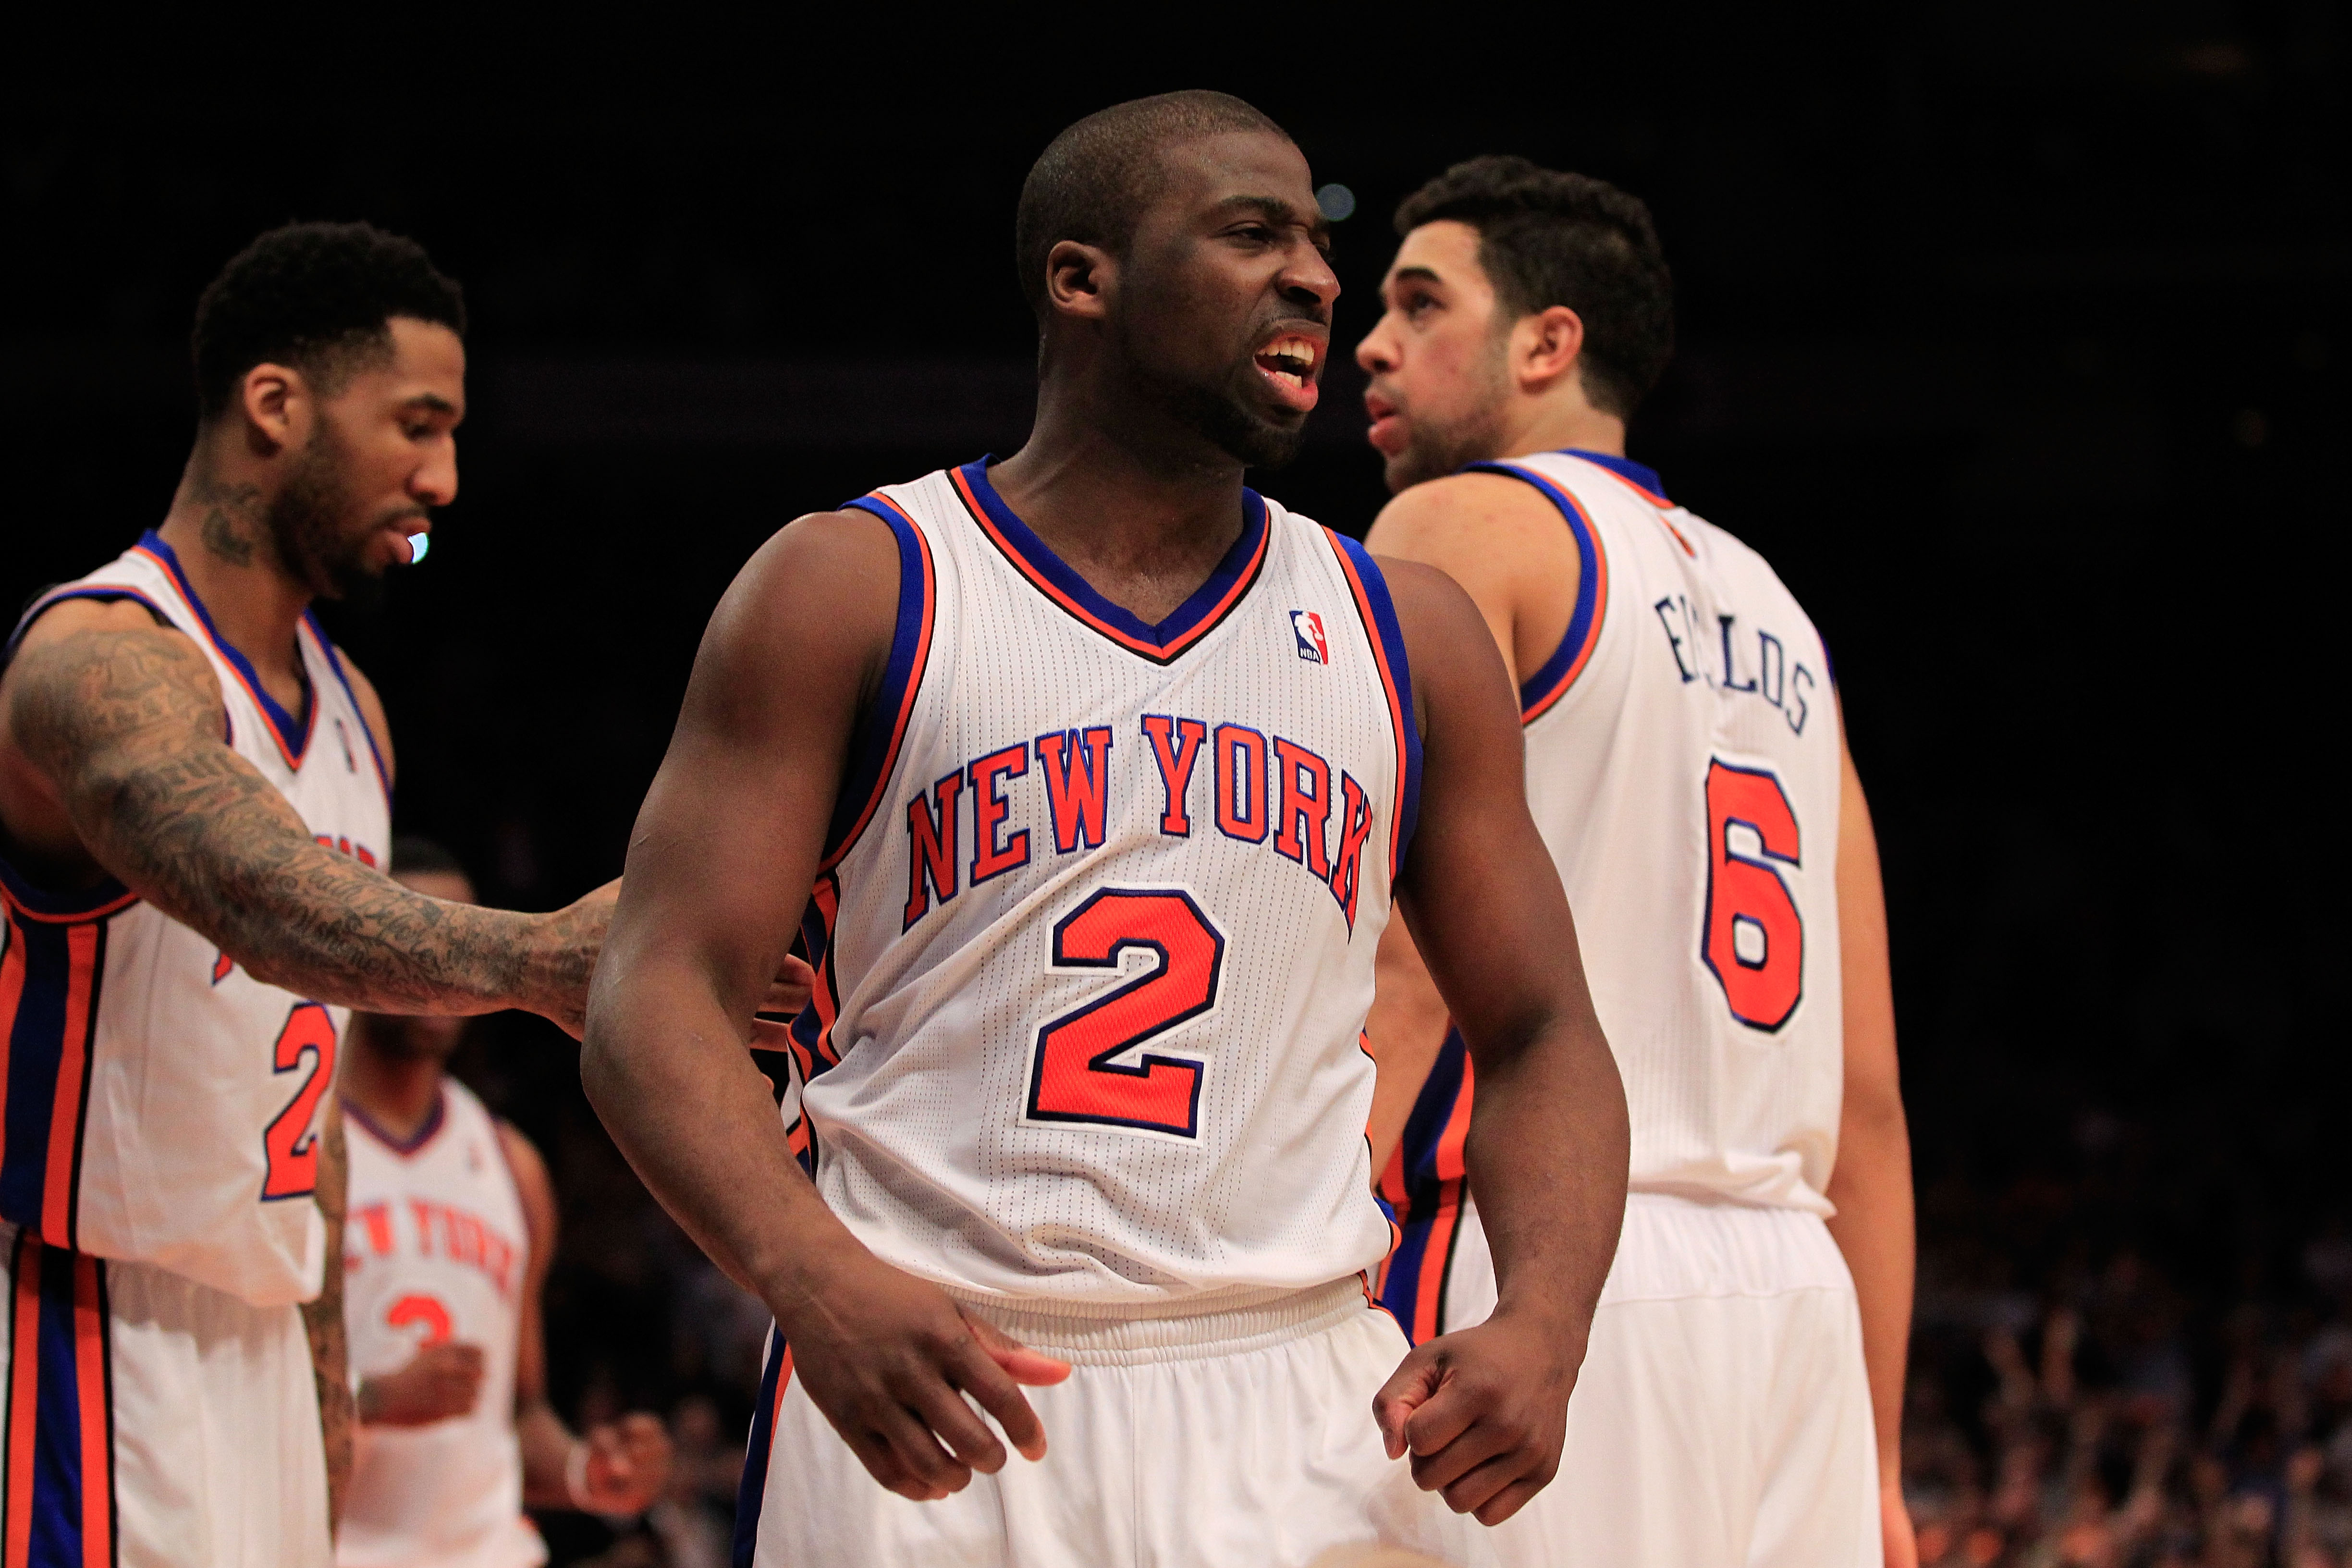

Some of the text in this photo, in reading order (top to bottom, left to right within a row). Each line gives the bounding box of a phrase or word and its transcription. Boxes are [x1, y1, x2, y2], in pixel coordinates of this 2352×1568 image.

[1300, 648, 1319, 662] NBA
[1654, 594, 1815, 737] FLDS
[901, 713, 1373, 945] NEW YORK
[1700, 754, 1804, 1035] 6
[260, 1000, 336, 1202] 2
[1025, 885, 1226, 1140] 2
